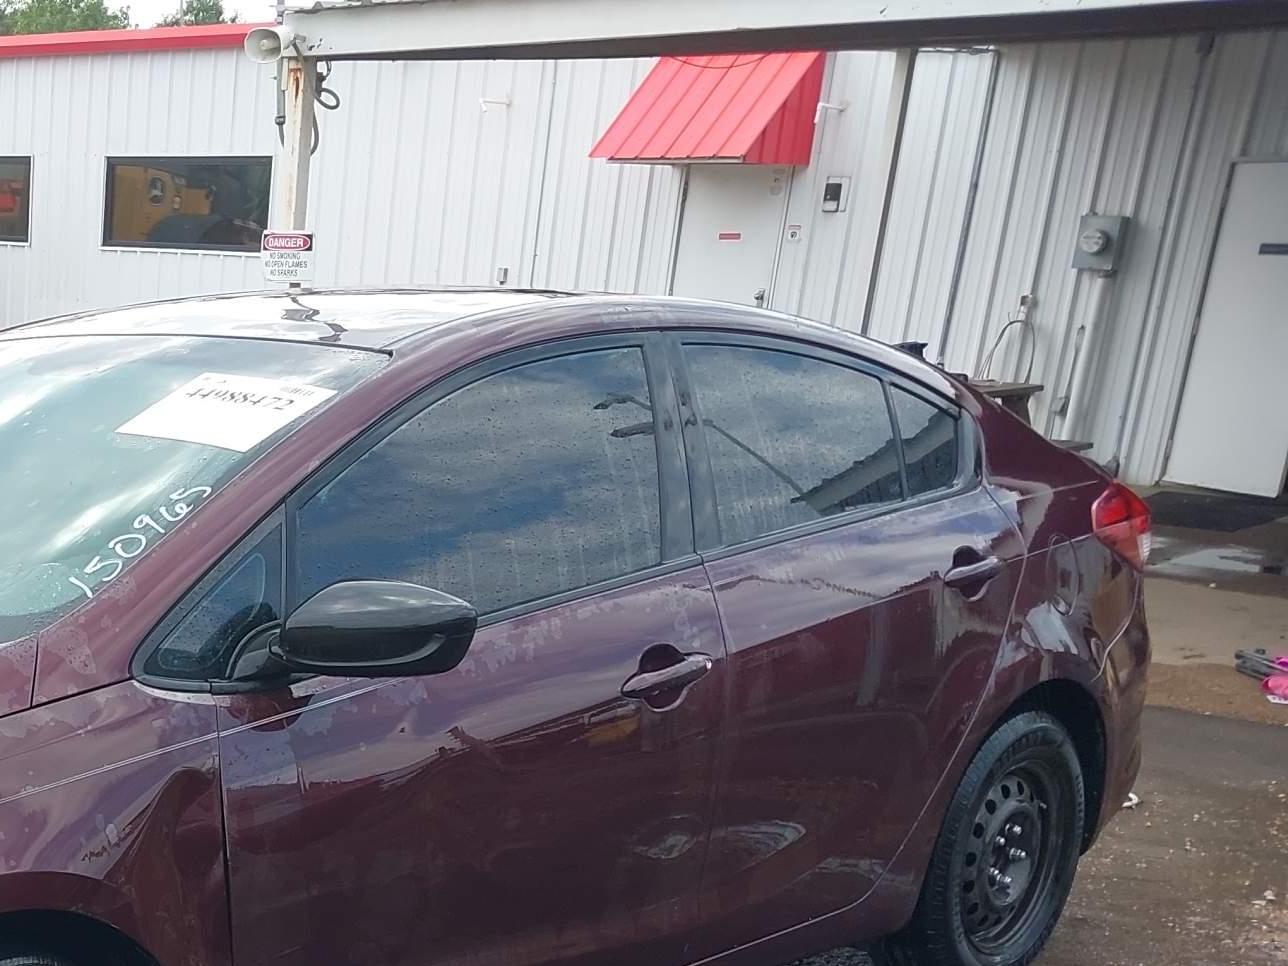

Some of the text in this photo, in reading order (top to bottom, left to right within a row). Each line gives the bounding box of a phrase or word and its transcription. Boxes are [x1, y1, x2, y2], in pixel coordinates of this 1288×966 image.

[268, 237, 304, 248] DANGER
[277, 252, 301, 260] SMOKING
[265, 260, 271, 268] NO
[272, 260, 284, 268] OPEN
[278, 269, 298, 277] SPARKS
[185, 387, 295, 411] 44988472
[68, 486, 212, 598] 150965
